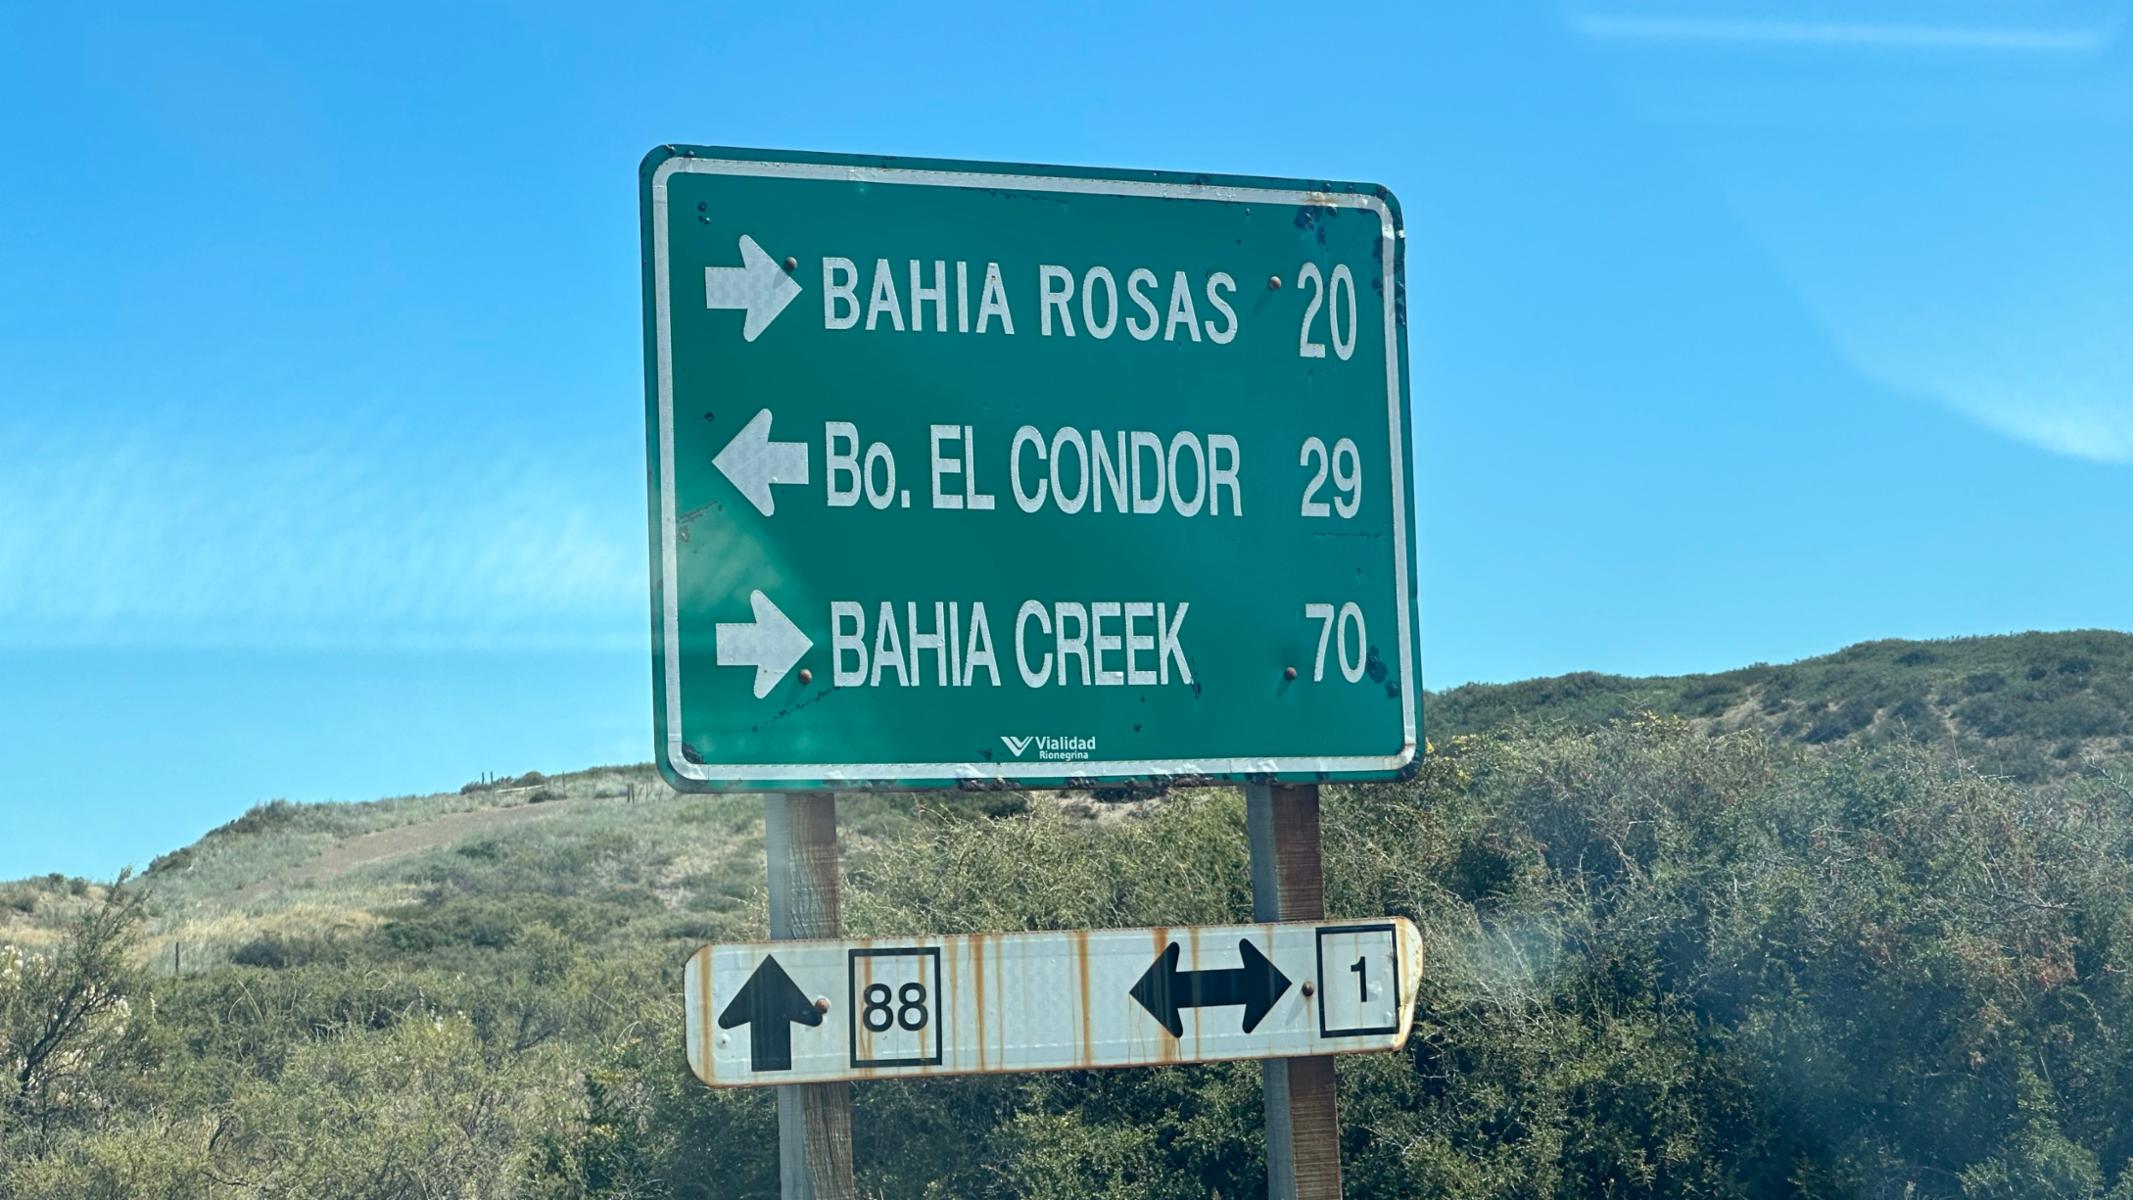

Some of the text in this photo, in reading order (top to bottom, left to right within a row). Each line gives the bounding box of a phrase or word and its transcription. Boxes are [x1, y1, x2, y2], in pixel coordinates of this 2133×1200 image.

[823, 257, 1358, 361] BAHIA ROSAS 20
[826, 421, 1362, 519] Bo. EL CONDOR 29
[831, 599, 1368, 688] BAHIA CREEK 70
[1035, 736, 1096, 750] Vialidad
[1039, 750, 1089, 761] Rionegrina
[1350, 955, 1369, 1004] 1
[863, 981, 929, 1034] 88
